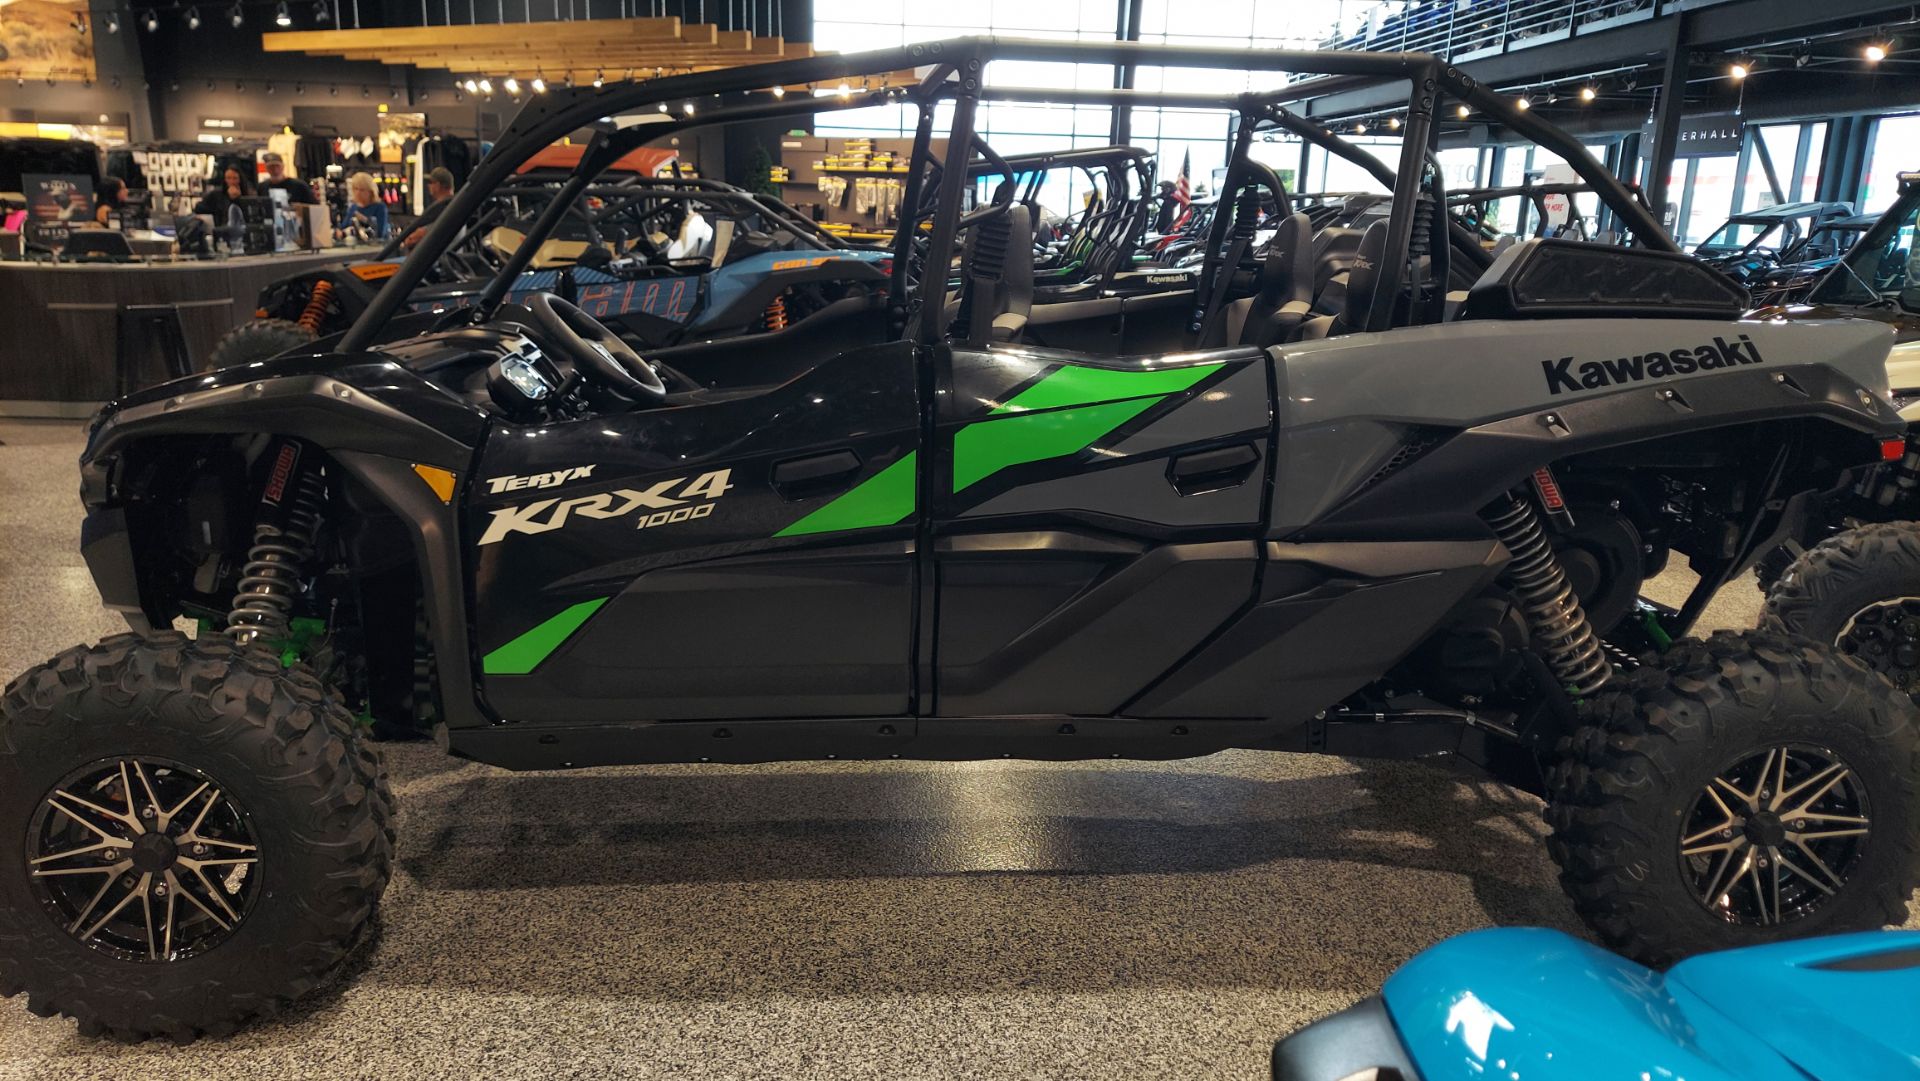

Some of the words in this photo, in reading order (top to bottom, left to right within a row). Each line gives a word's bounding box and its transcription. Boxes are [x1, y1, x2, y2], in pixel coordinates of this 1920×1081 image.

[1146, 273, 1188, 283] Kawasaki
[1541, 334, 1763, 395] Kawasaki
[264, 446, 297, 501] SHOWA
[1534, 467, 1563, 508] HOWA
[636, 502, 716, 530] 1000
